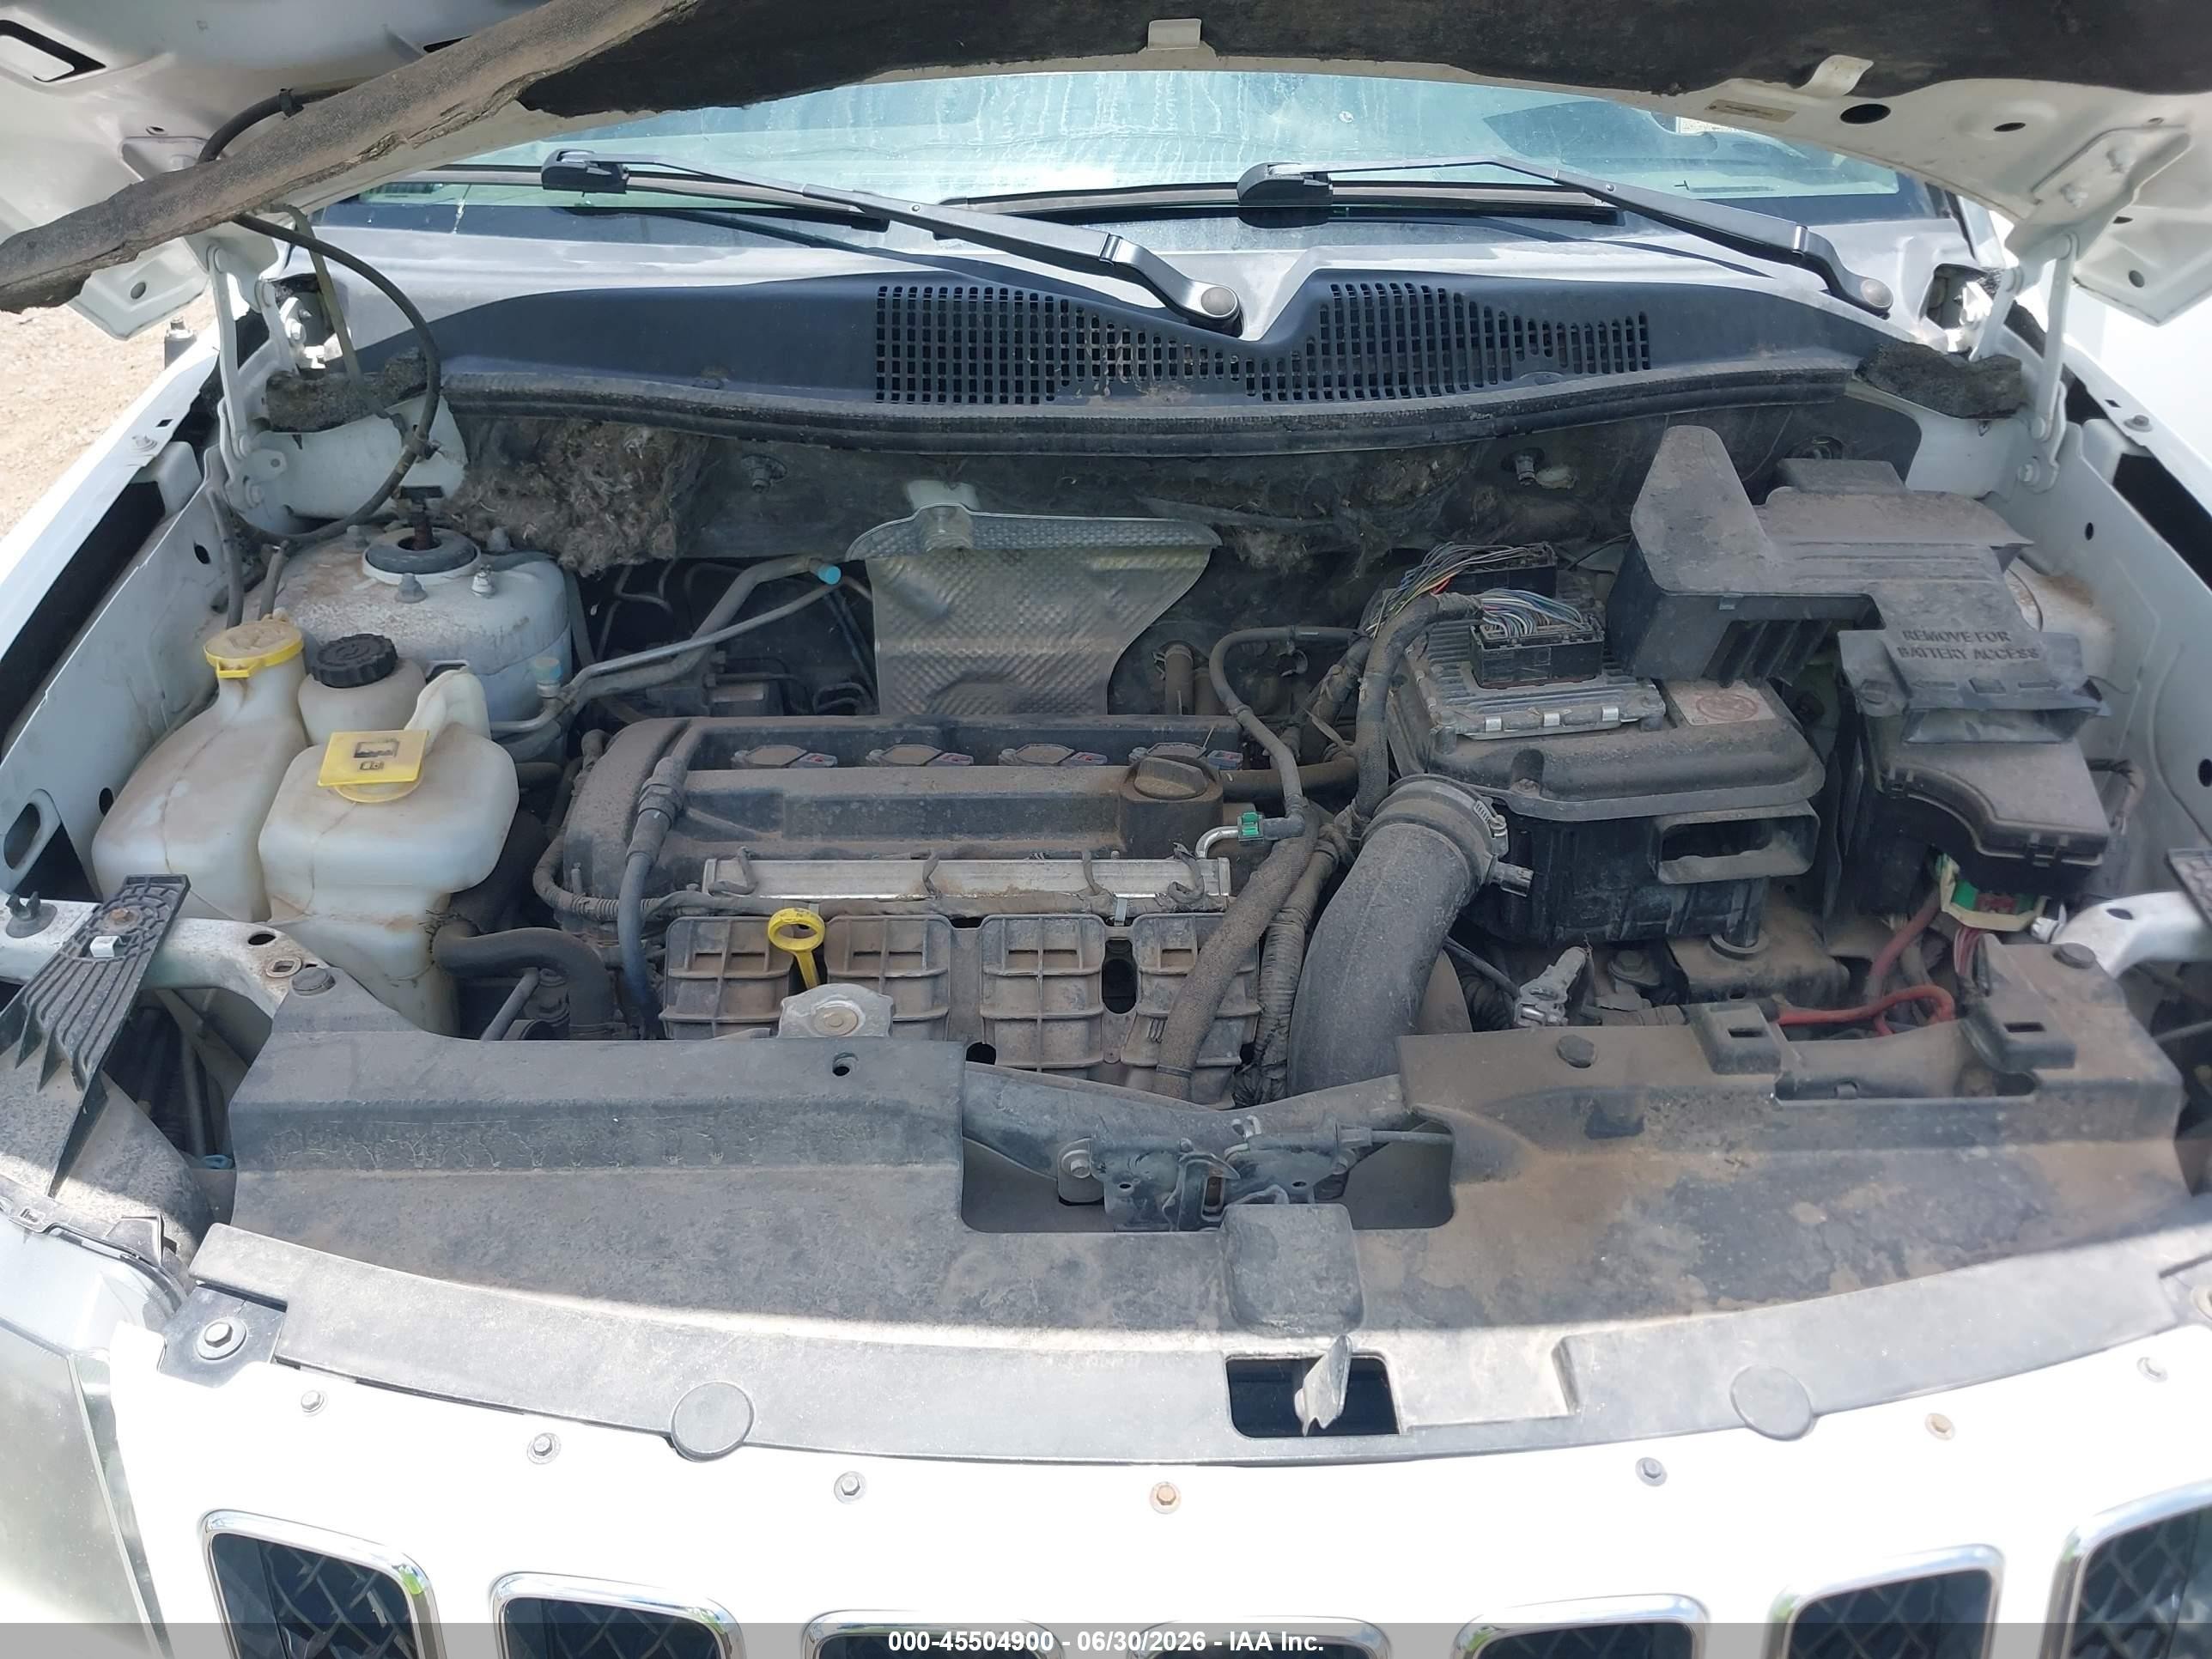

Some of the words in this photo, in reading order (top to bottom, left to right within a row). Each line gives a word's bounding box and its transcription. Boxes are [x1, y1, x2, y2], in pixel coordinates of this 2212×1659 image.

[1902, 629, 1972, 642] REMOVE
[1975, 630, 2012, 643] FOR
[1897, 646, 1968, 660] BATTERY
[1973, 647, 2040, 660] ACCESS
